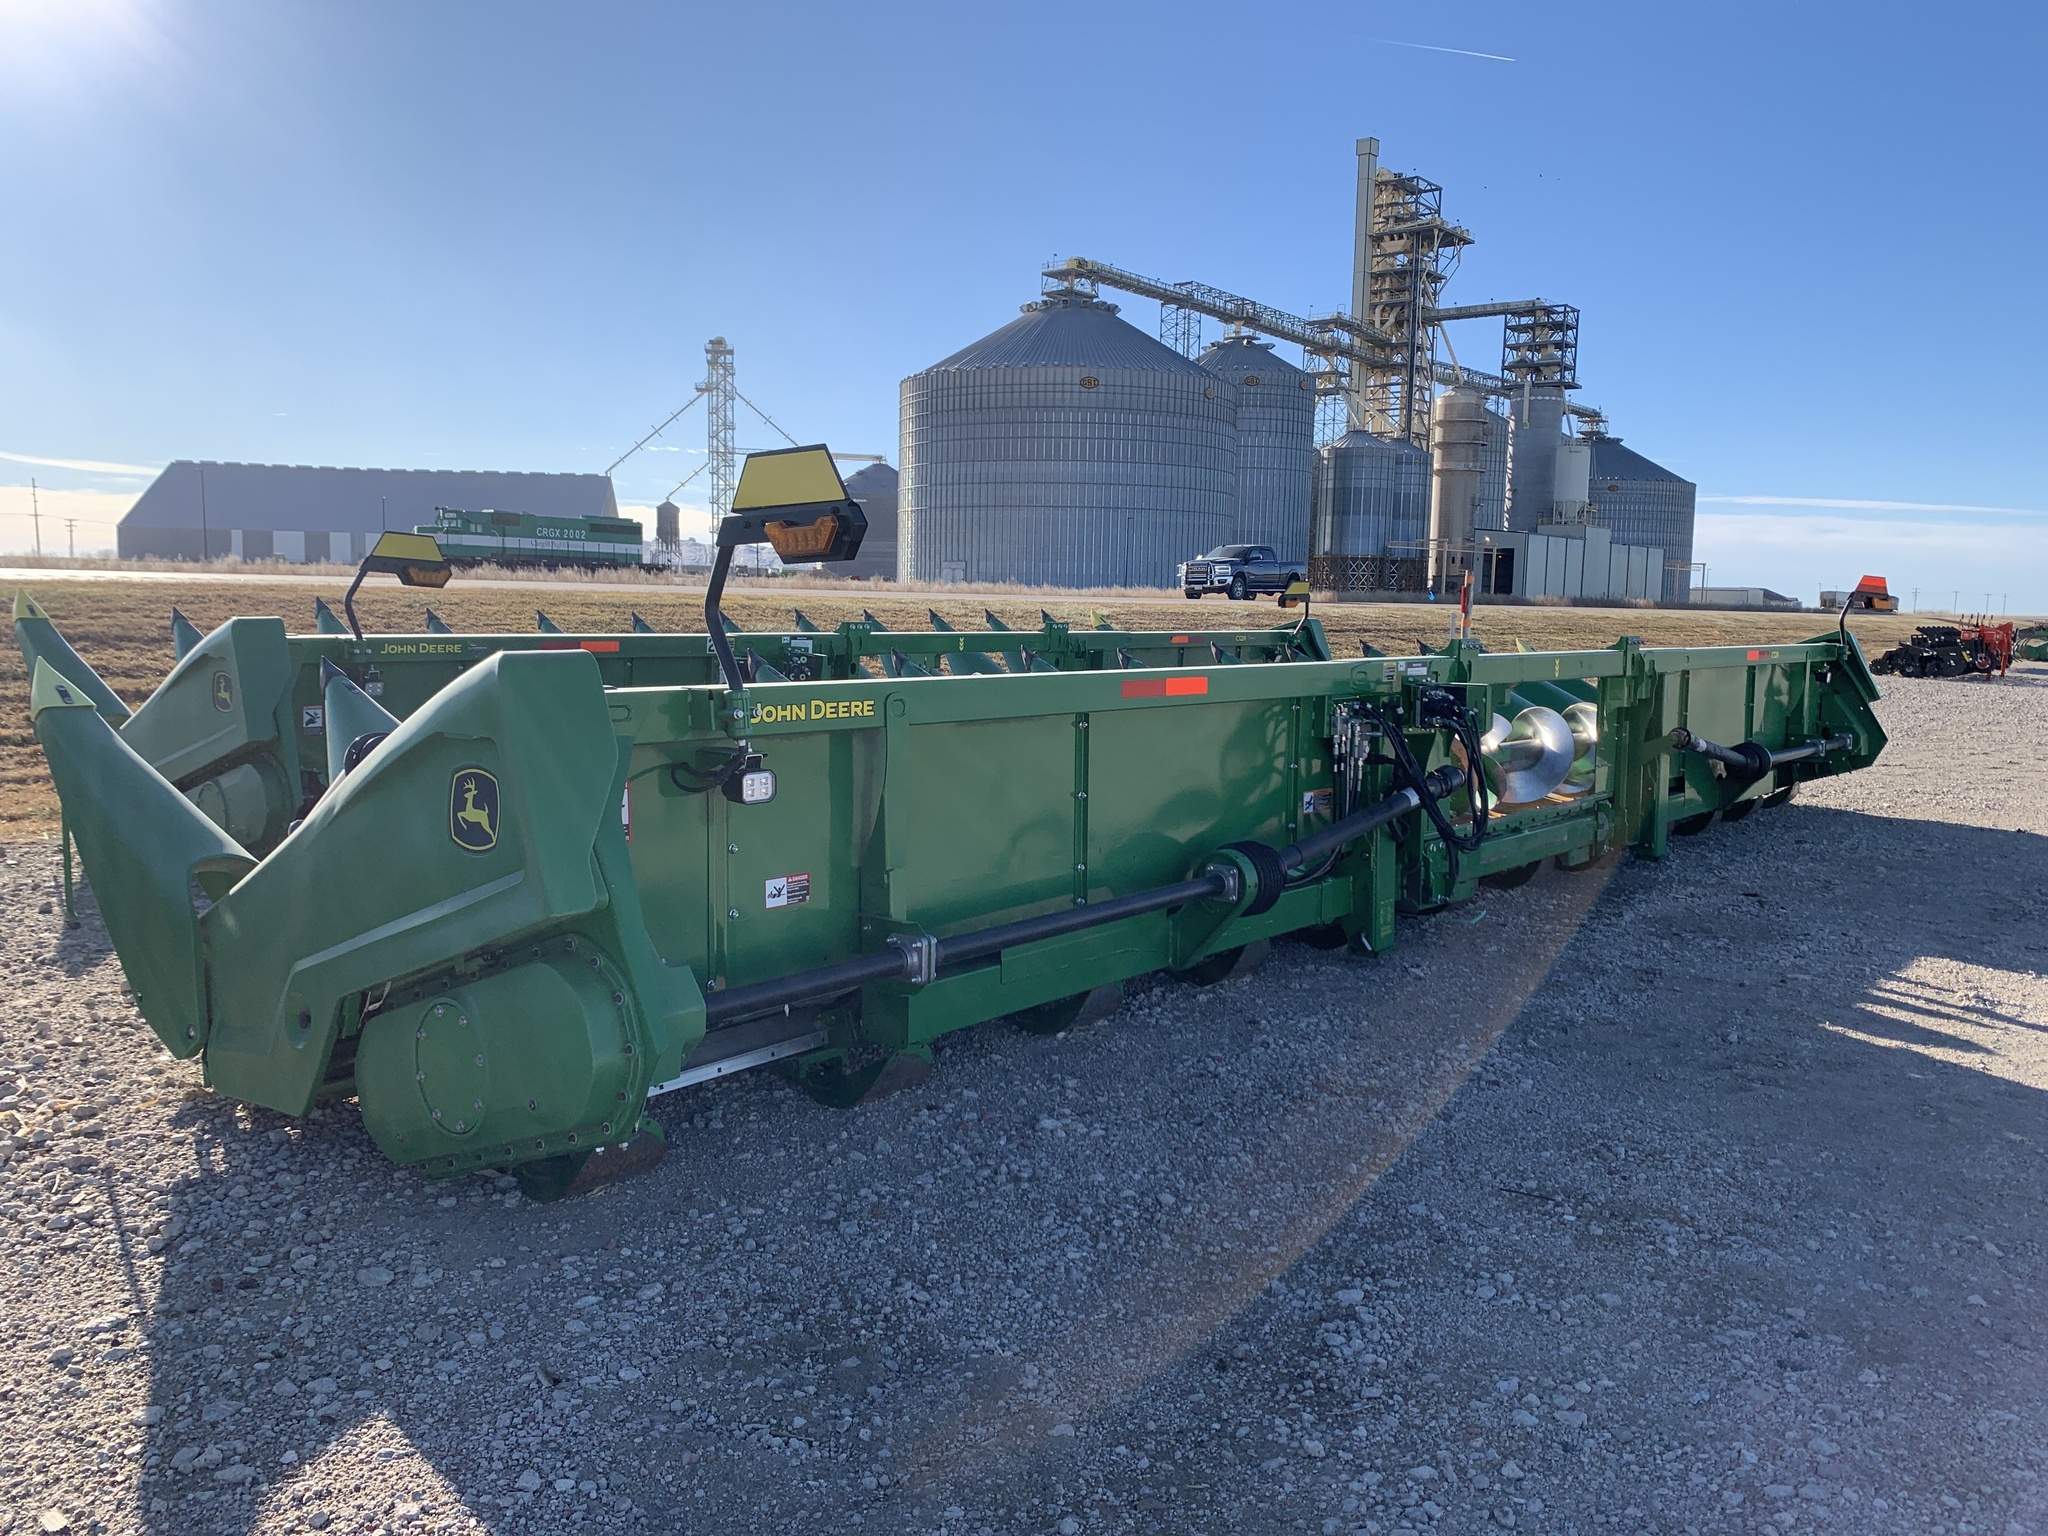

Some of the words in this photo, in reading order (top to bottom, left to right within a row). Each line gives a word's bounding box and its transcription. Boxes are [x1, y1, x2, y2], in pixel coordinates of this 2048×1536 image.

[536, 527, 561, 537] CRGX
[563, 529, 586, 539] 2002
[380, 643, 417, 654] JOHN
[419, 643, 463, 654] DEERE
[750, 703, 806, 724] JOHN
[810, 699, 875, 720] DEERE
